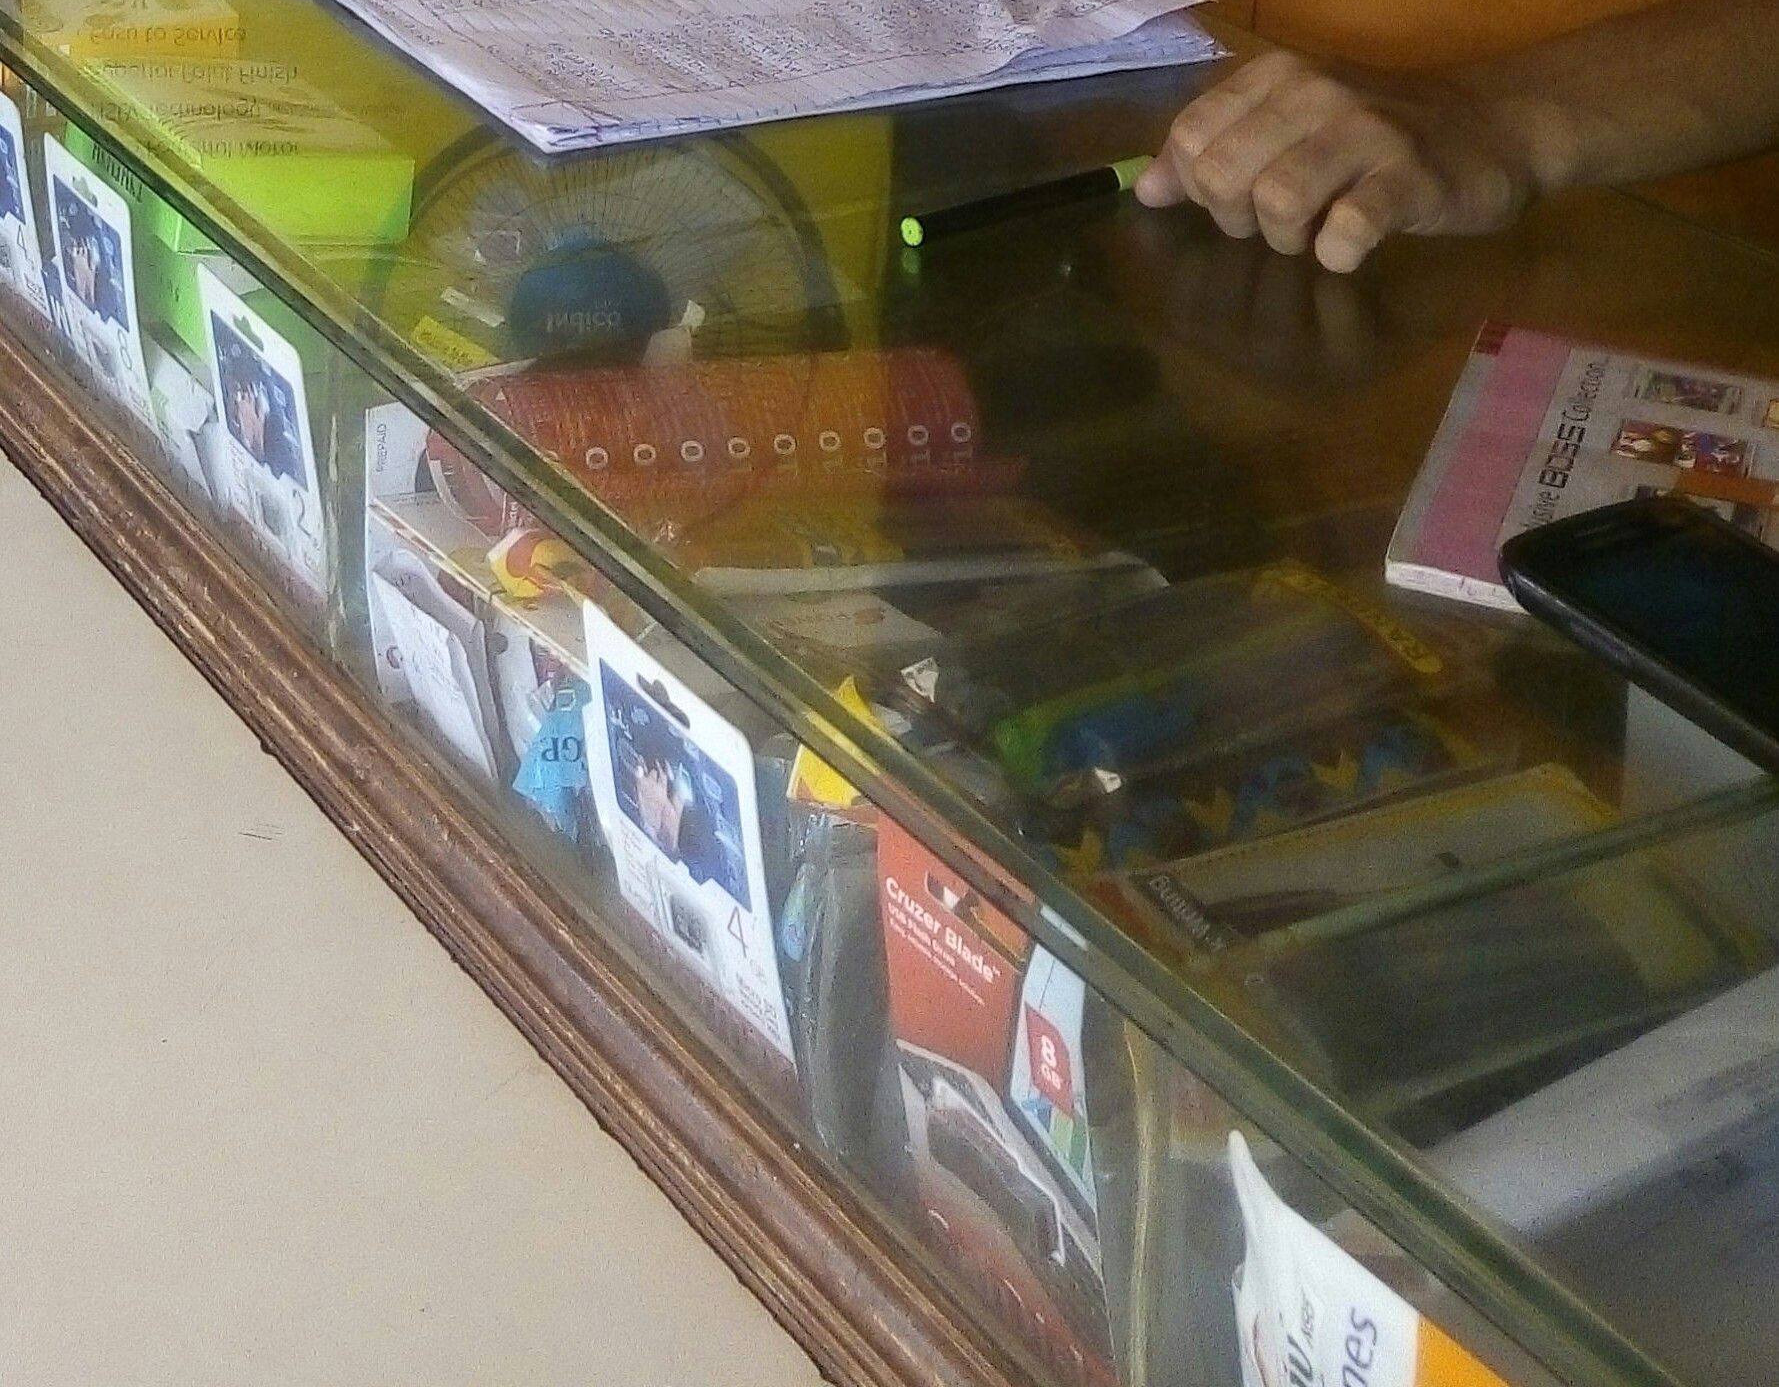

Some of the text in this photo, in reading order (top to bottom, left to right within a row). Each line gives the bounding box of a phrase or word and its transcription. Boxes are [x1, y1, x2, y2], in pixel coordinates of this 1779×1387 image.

[886, 877, 941, 935] Cruzer
[944, 926, 995, 985] Blade
[1040, 1033, 1058, 1066] 8
[1040, 1062, 1062, 1091] GB
